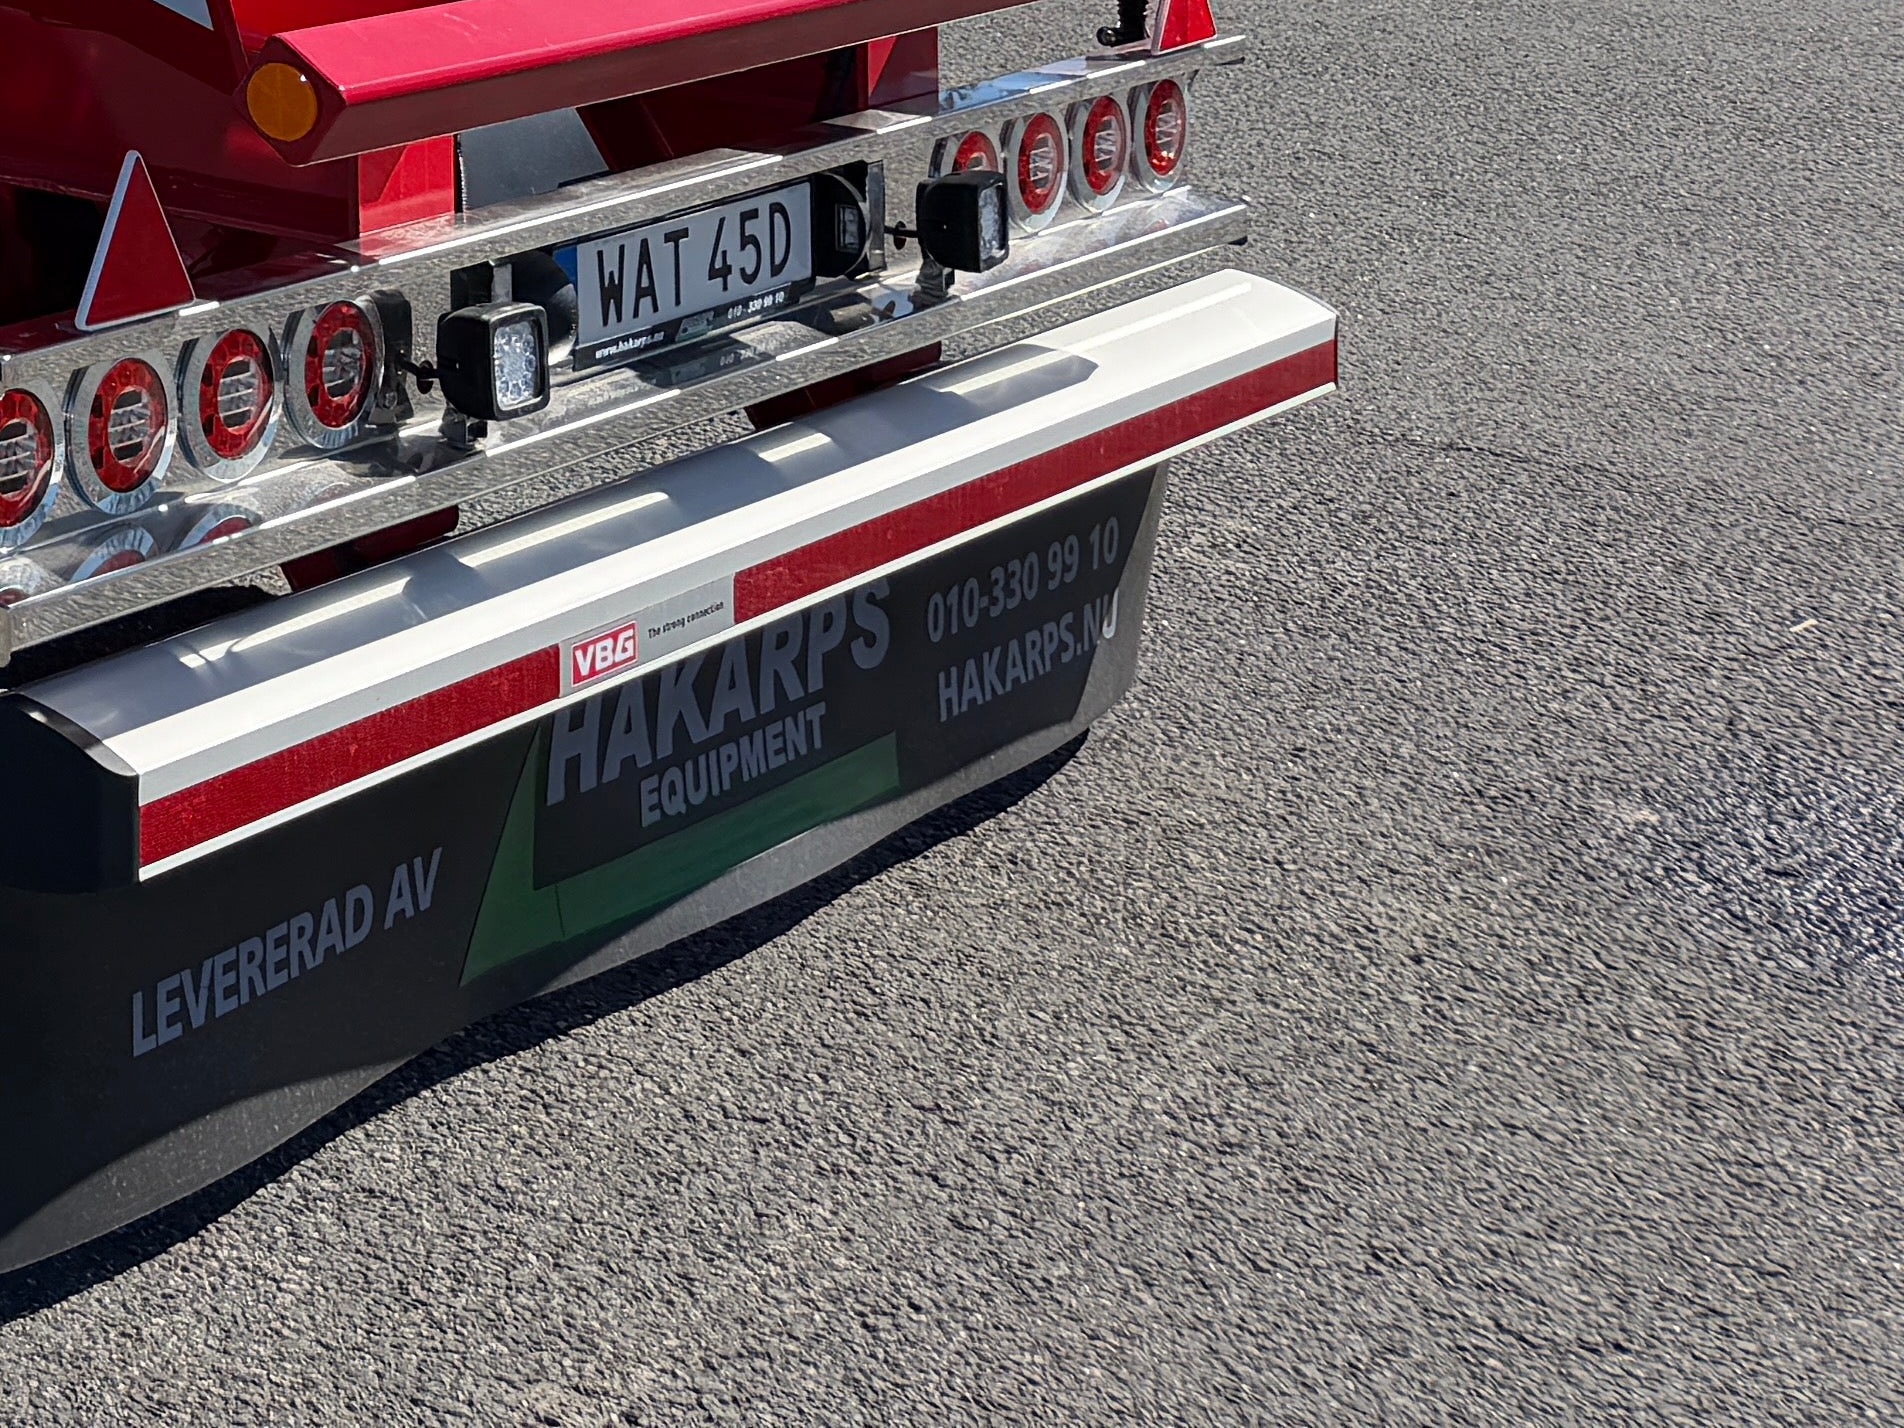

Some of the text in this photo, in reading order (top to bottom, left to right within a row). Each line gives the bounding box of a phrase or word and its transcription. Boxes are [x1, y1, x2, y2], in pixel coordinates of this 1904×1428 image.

[596, 202, 791, 327] WAT 45D
[574, 601, 724, 676] VBG The strong connection
[927, 516, 1119, 643] 010-330 99 10
[547, 577, 891, 806] HAKARPS
[938, 587, 1119, 723] HAKARPS.NU
[640, 702, 826, 828] EQUIPMENT
[132, 846, 442, 1057] LEVERERAD AV
